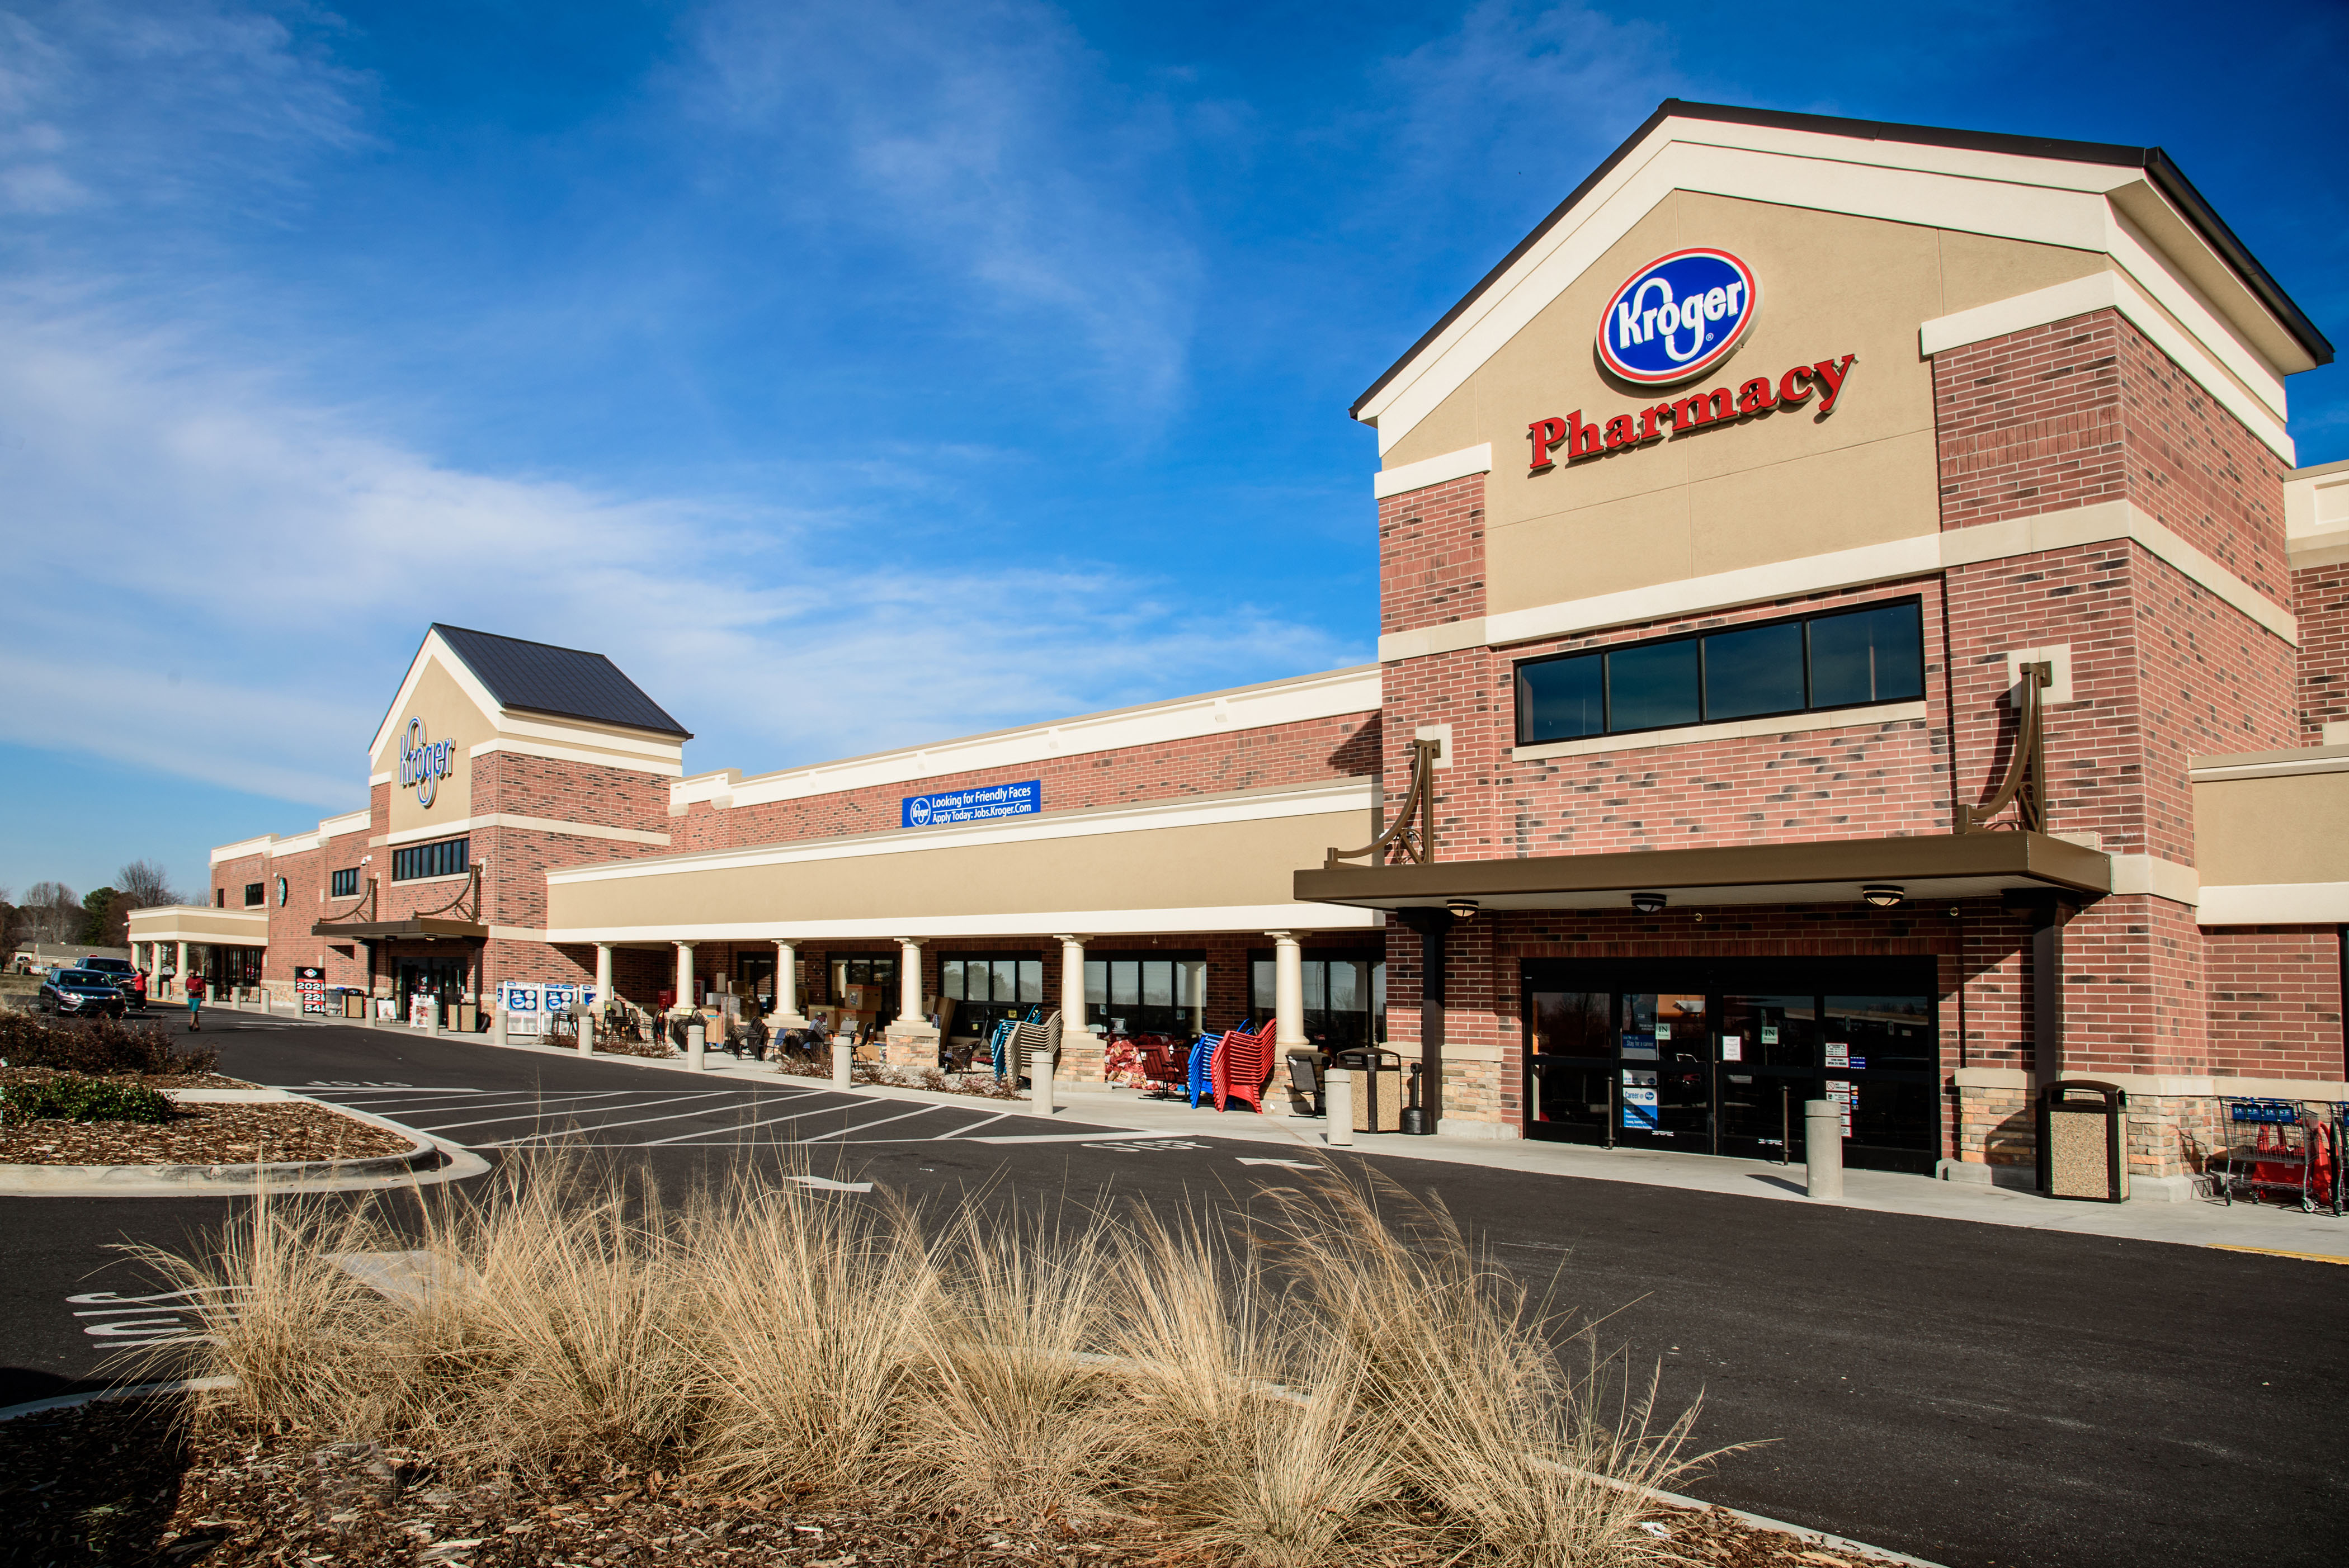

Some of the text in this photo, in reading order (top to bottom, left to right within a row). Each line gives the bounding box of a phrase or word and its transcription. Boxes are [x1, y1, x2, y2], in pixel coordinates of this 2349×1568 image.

[1618, 277, 1742, 362] Kroger
[1529, 353, 1856, 469] Pharmacy
[400, 716, 455, 806] Kroger
[932, 786, 1031, 808] Looking for Friendly Faces
[913, 804, 928, 823] Kroger
[932, 804, 1031, 824] Apply Today: Jobs.Kroger.Com
[1081, 1140, 1213, 1152] STOP
